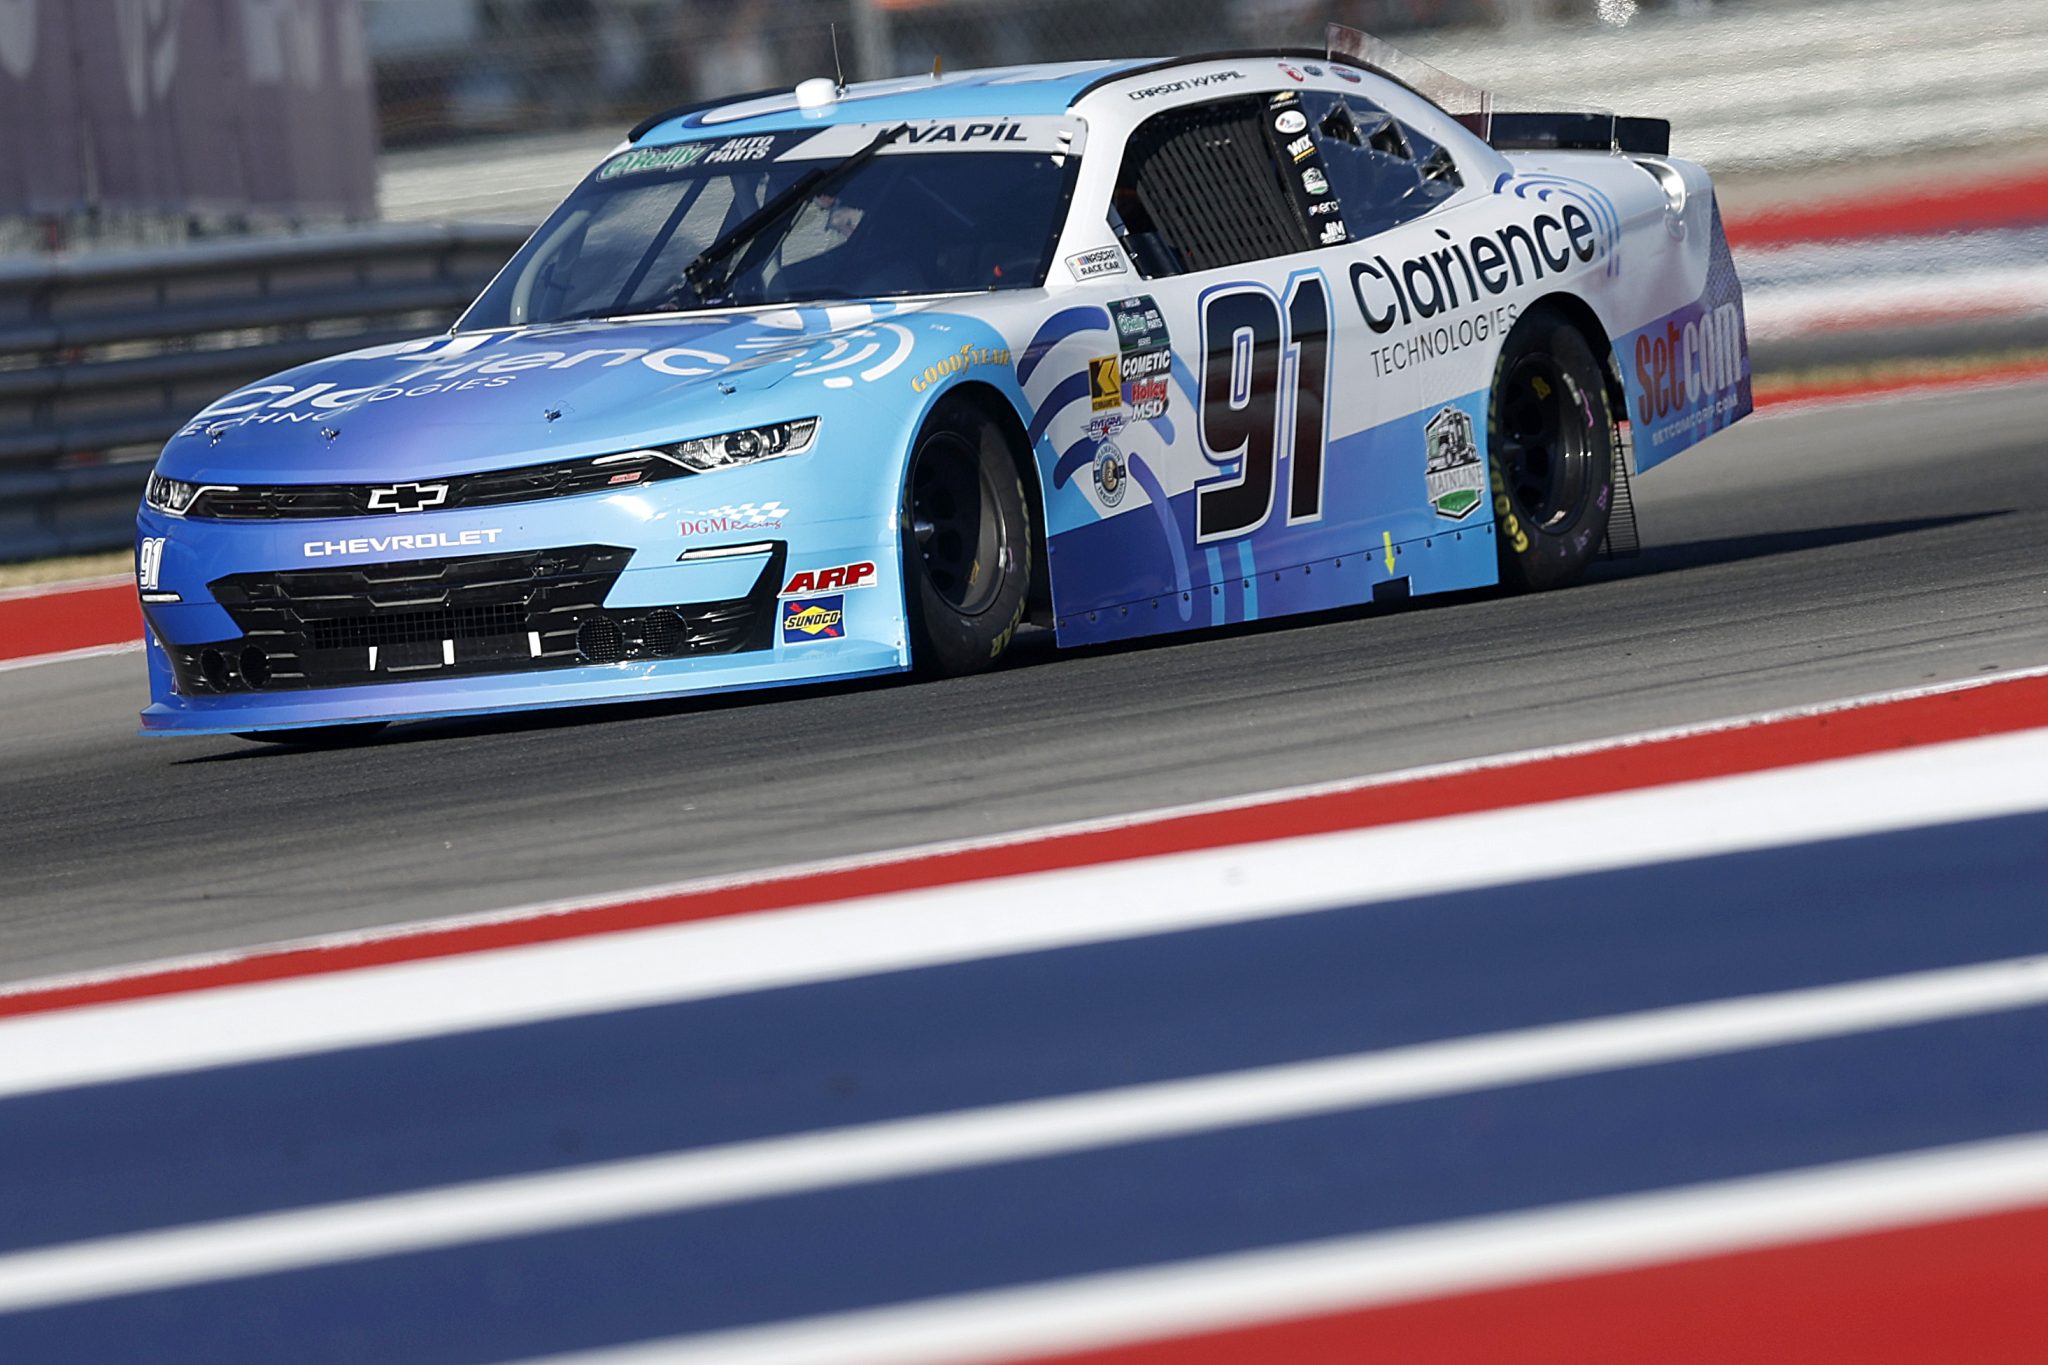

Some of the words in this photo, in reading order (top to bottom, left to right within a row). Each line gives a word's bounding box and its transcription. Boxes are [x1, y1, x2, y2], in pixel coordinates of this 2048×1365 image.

[1127, 80, 1191, 101] CARSON
[719, 135, 775, 151] AUTO
[1287, 133, 1314, 156] WIX
[703, 147, 770, 164] PARTS
[1080, 263, 1103, 276] RACE
[1103, 260, 1120, 272] CAR
[1086, 249, 1116, 264] NASCAR
[1349, 204, 1595, 334] Clarience
[1371, 303, 1519, 378] TECHNOLOGIES
[911, 343, 1010, 393] GOODYEAR
[1122, 350, 1171, 379] COMETIC
[1132, 379, 1168, 403] Holley
[1133, 400, 1164, 422] MSD
[1196, 272, 1331, 545] 91
[679, 517, 729, 536] DGM
[731, 519, 782, 530] Racing
[303, 528, 503, 558] CHEVROLET
[139, 537, 166, 591] 91
[783, 562, 875, 593] ARP
[787, 611, 839, 629] SUNOCO
